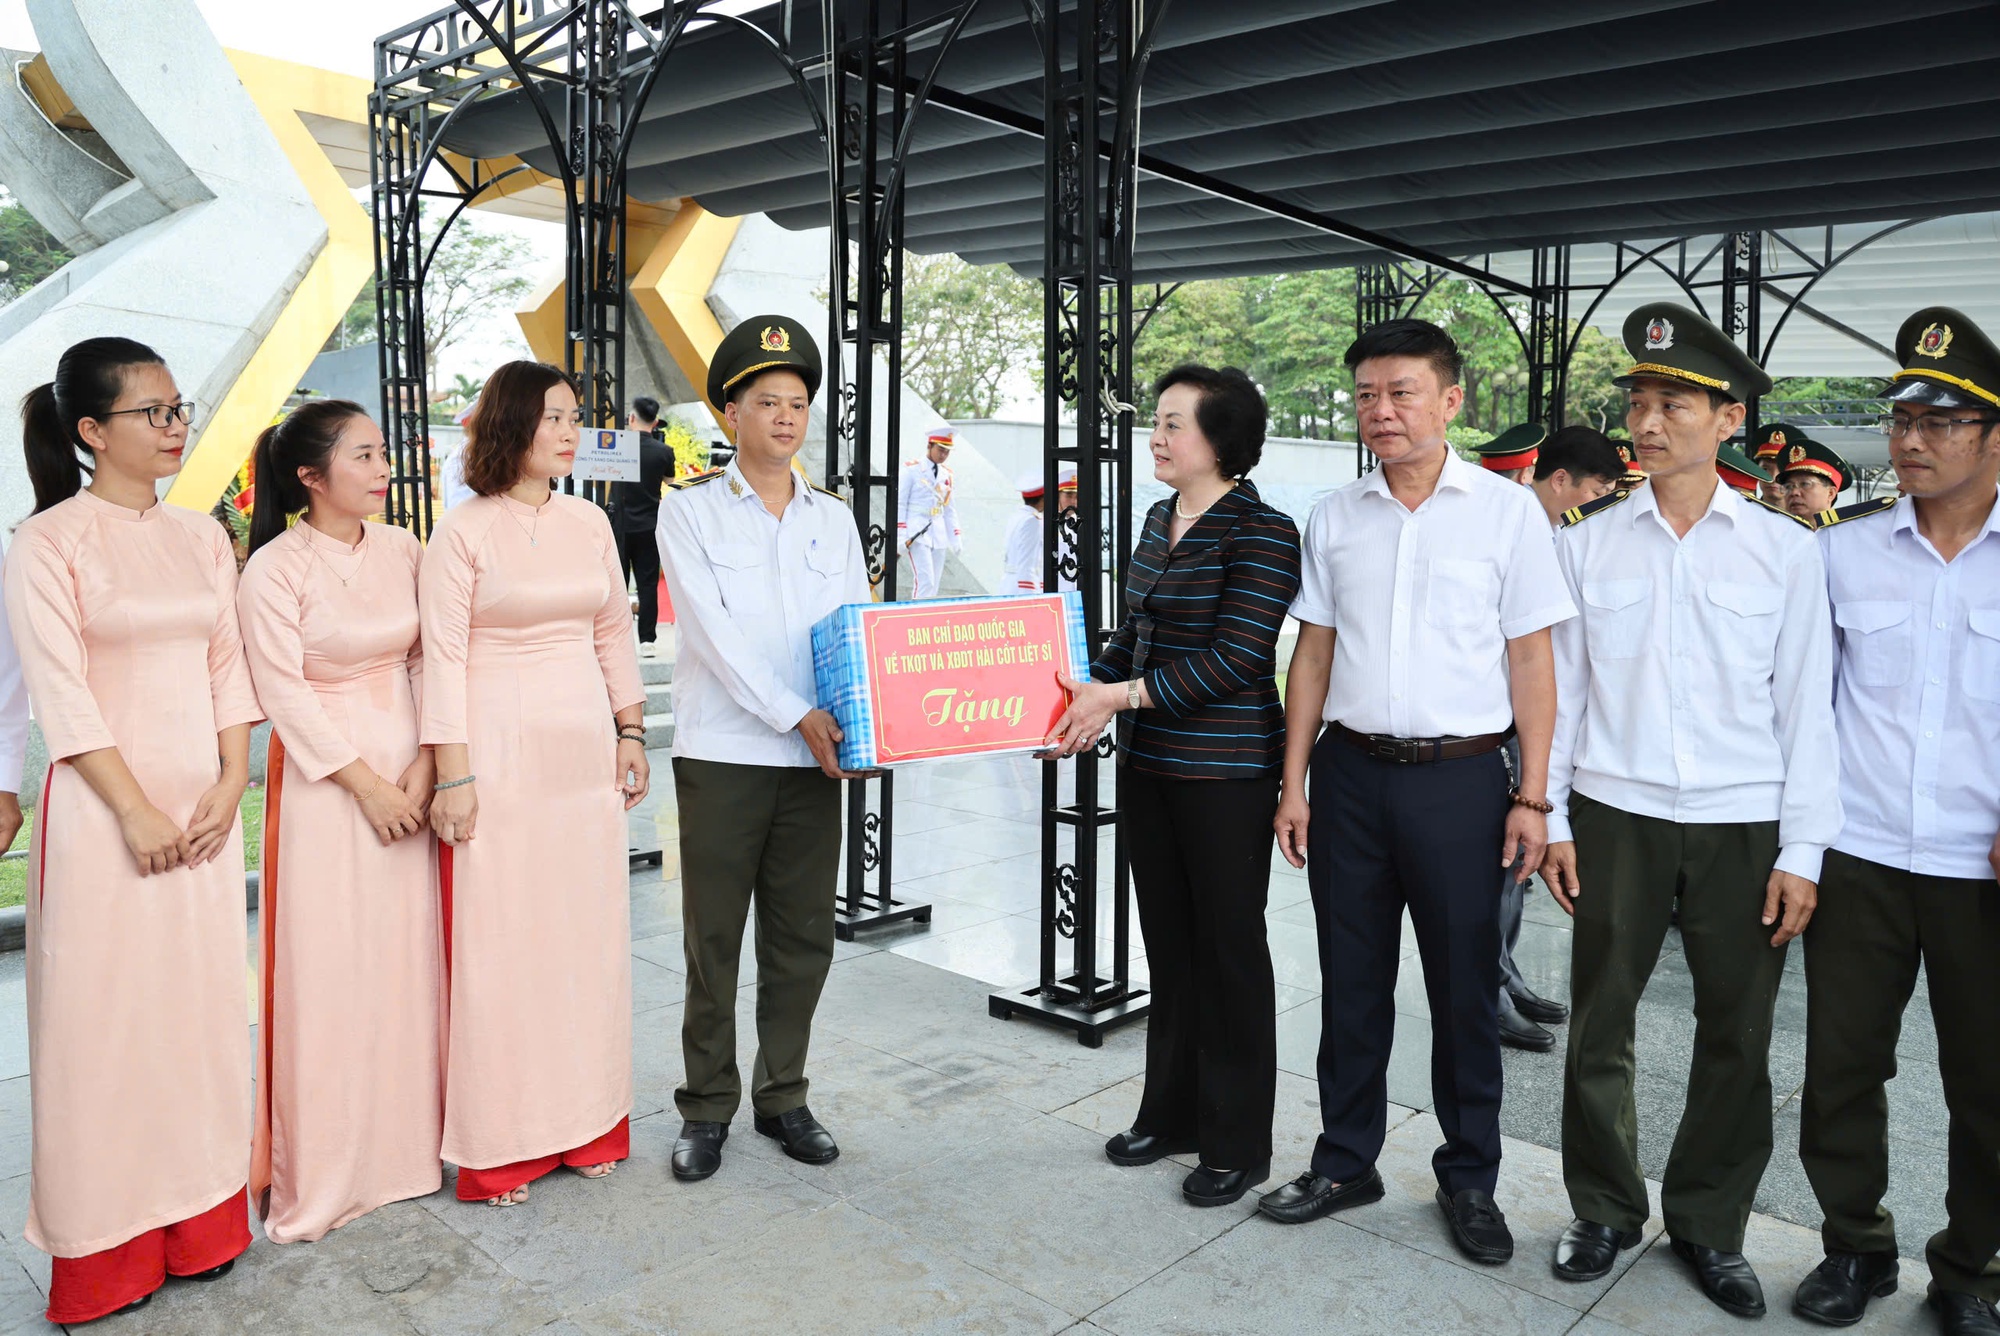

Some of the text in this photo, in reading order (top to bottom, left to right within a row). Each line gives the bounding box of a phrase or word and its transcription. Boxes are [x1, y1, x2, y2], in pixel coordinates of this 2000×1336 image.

[908, 616, 1026, 646] BAN CHỈ ĐẠO QUỐC GIA
[884, 651, 899, 675] VỀ
[901, 653, 927, 674] TKQT
[930, 647, 945, 670] VÀ
[976, 645, 995, 667] HÀI
[996, 640, 1016, 665] CỐT
[1018, 642, 1039, 667] LIỆT
[1041, 640, 1053, 661] SĨ
[921, 688, 1029, 733] Tặng
